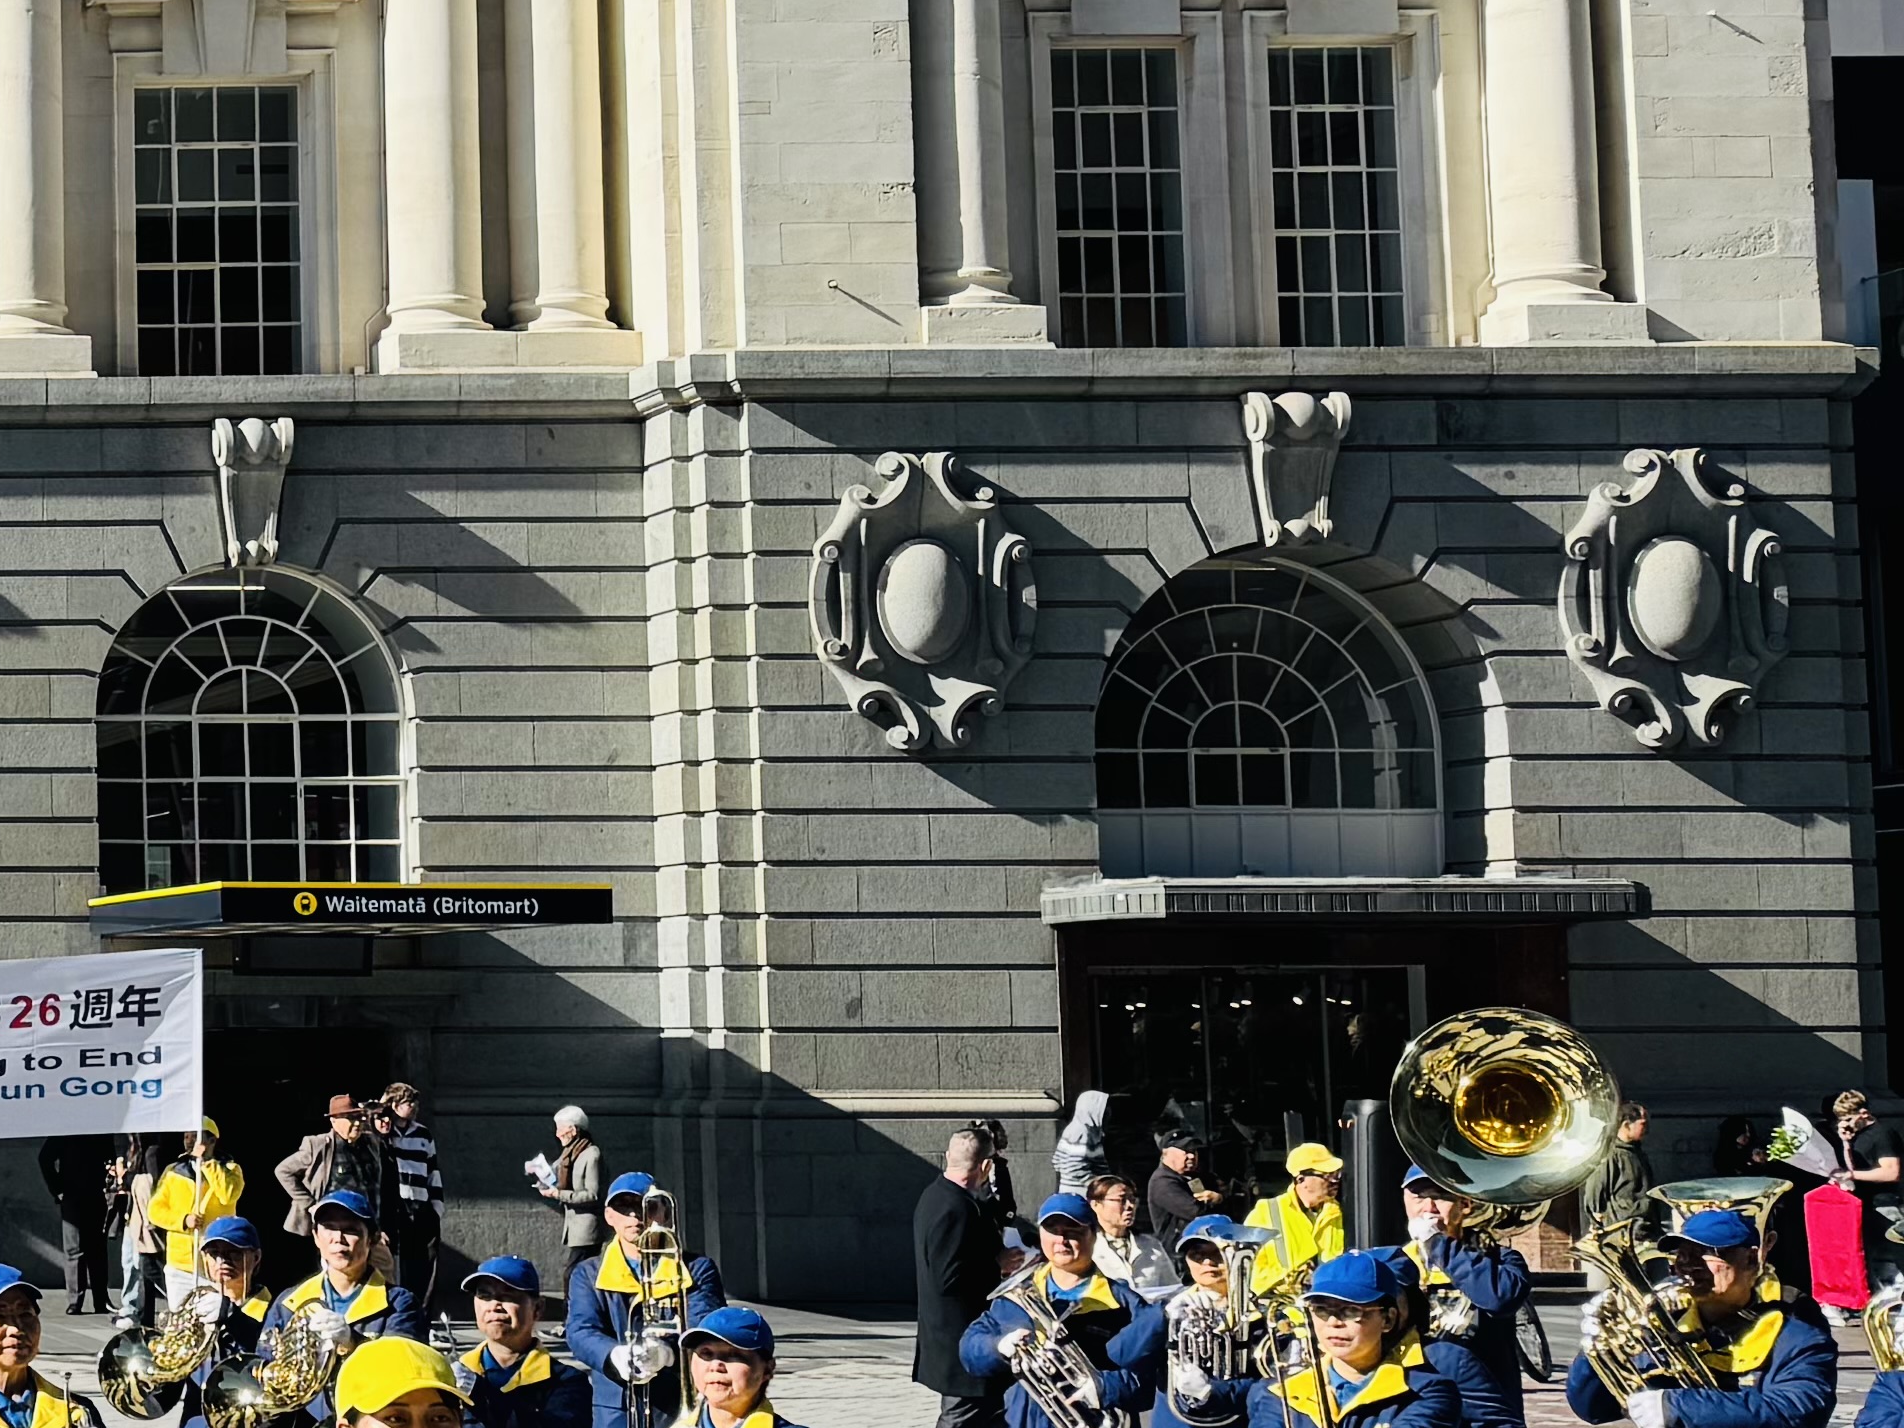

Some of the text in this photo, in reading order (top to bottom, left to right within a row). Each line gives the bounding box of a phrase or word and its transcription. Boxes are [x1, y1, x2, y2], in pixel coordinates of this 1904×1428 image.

[325, 895, 539, 916] Waitematā (Britomart)
[22, 1052, 63, 1071] to
[79, 1046, 162, 1068] End
[60, 1077, 162, 1100] Gong
